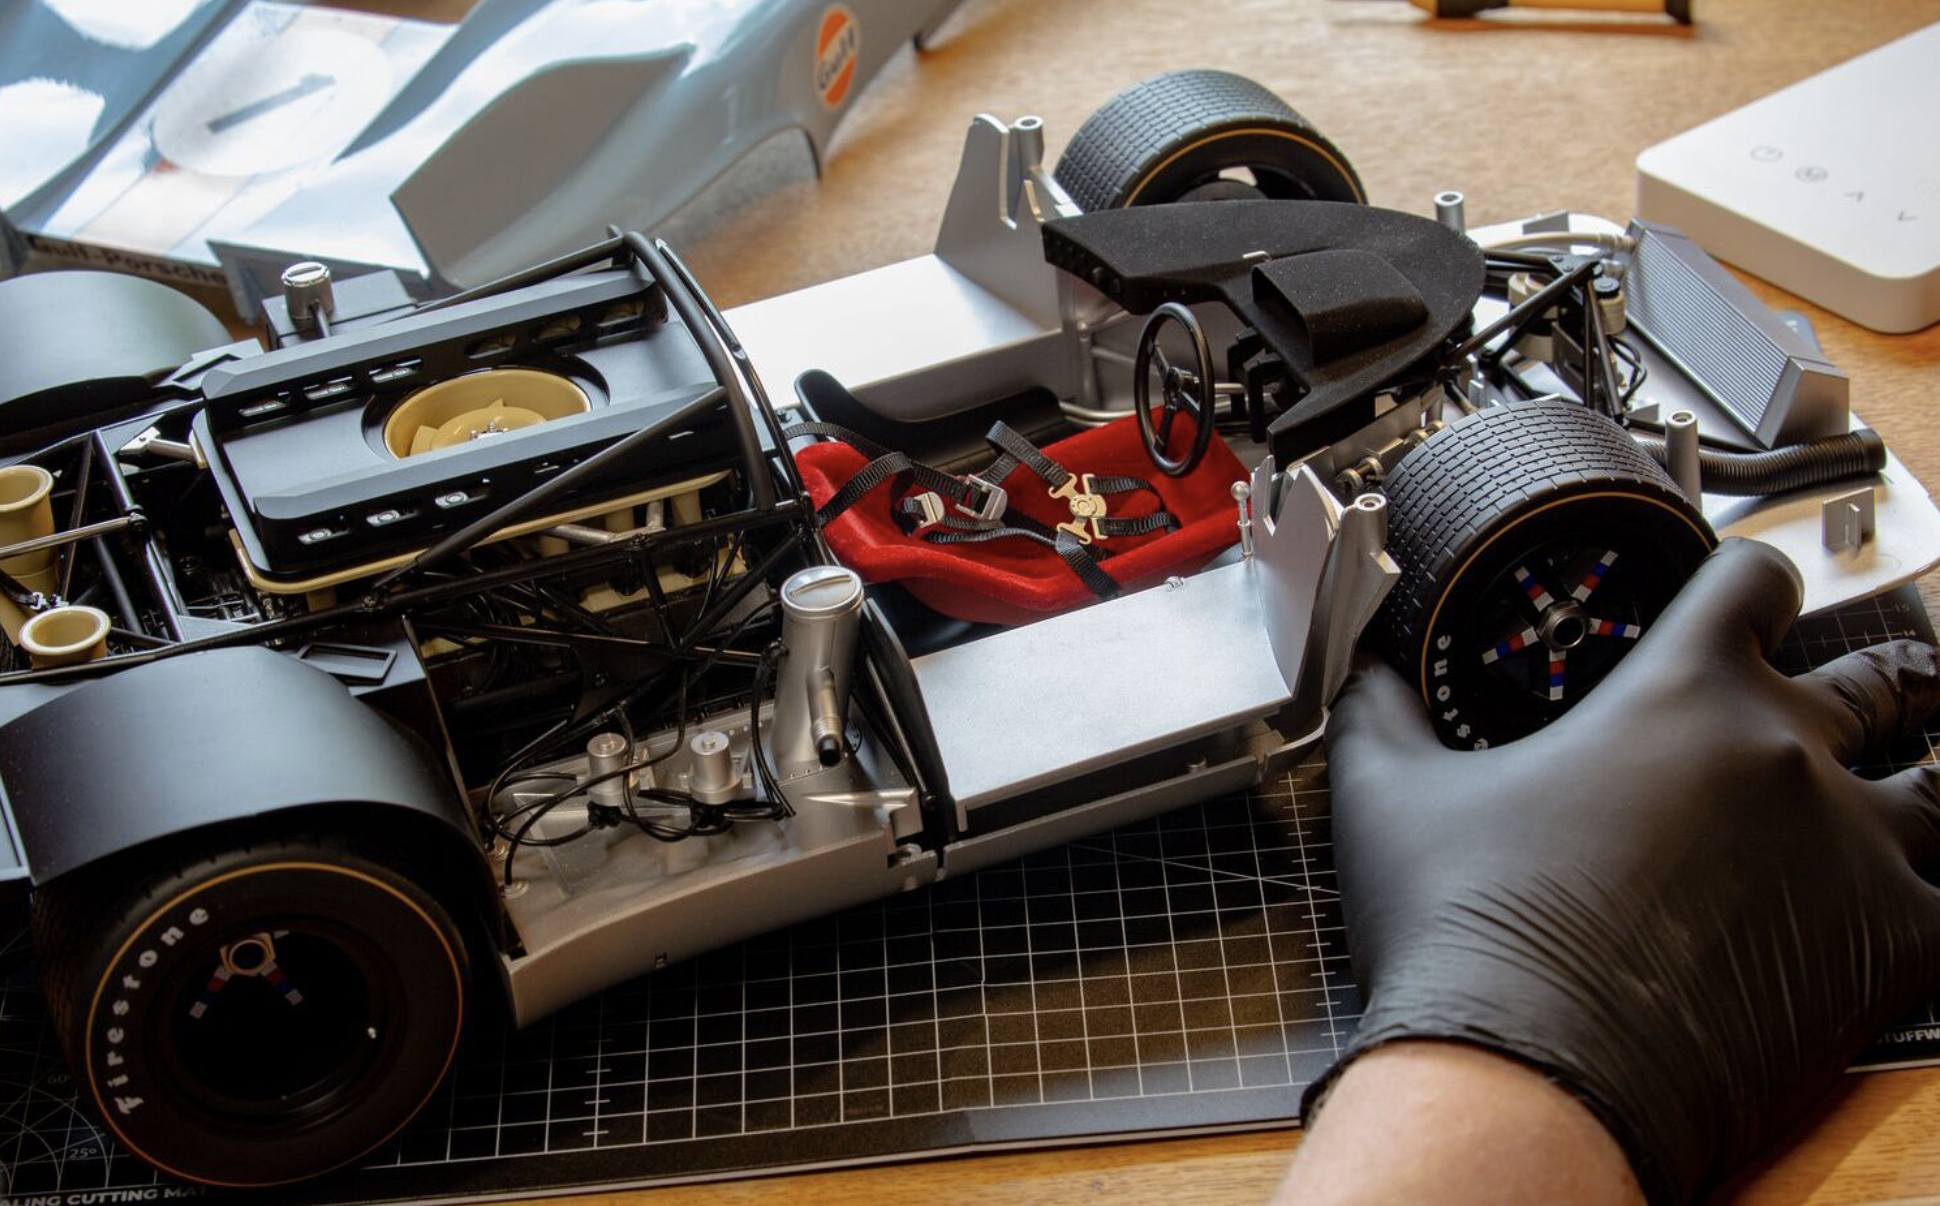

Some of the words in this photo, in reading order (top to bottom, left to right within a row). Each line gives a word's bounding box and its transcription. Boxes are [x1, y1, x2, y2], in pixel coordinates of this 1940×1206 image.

[1434, 635, 1489, 751] estone
[107, 908, 209, 1114] Firestone
[66, 1189, 158, 1206] CUTTING
